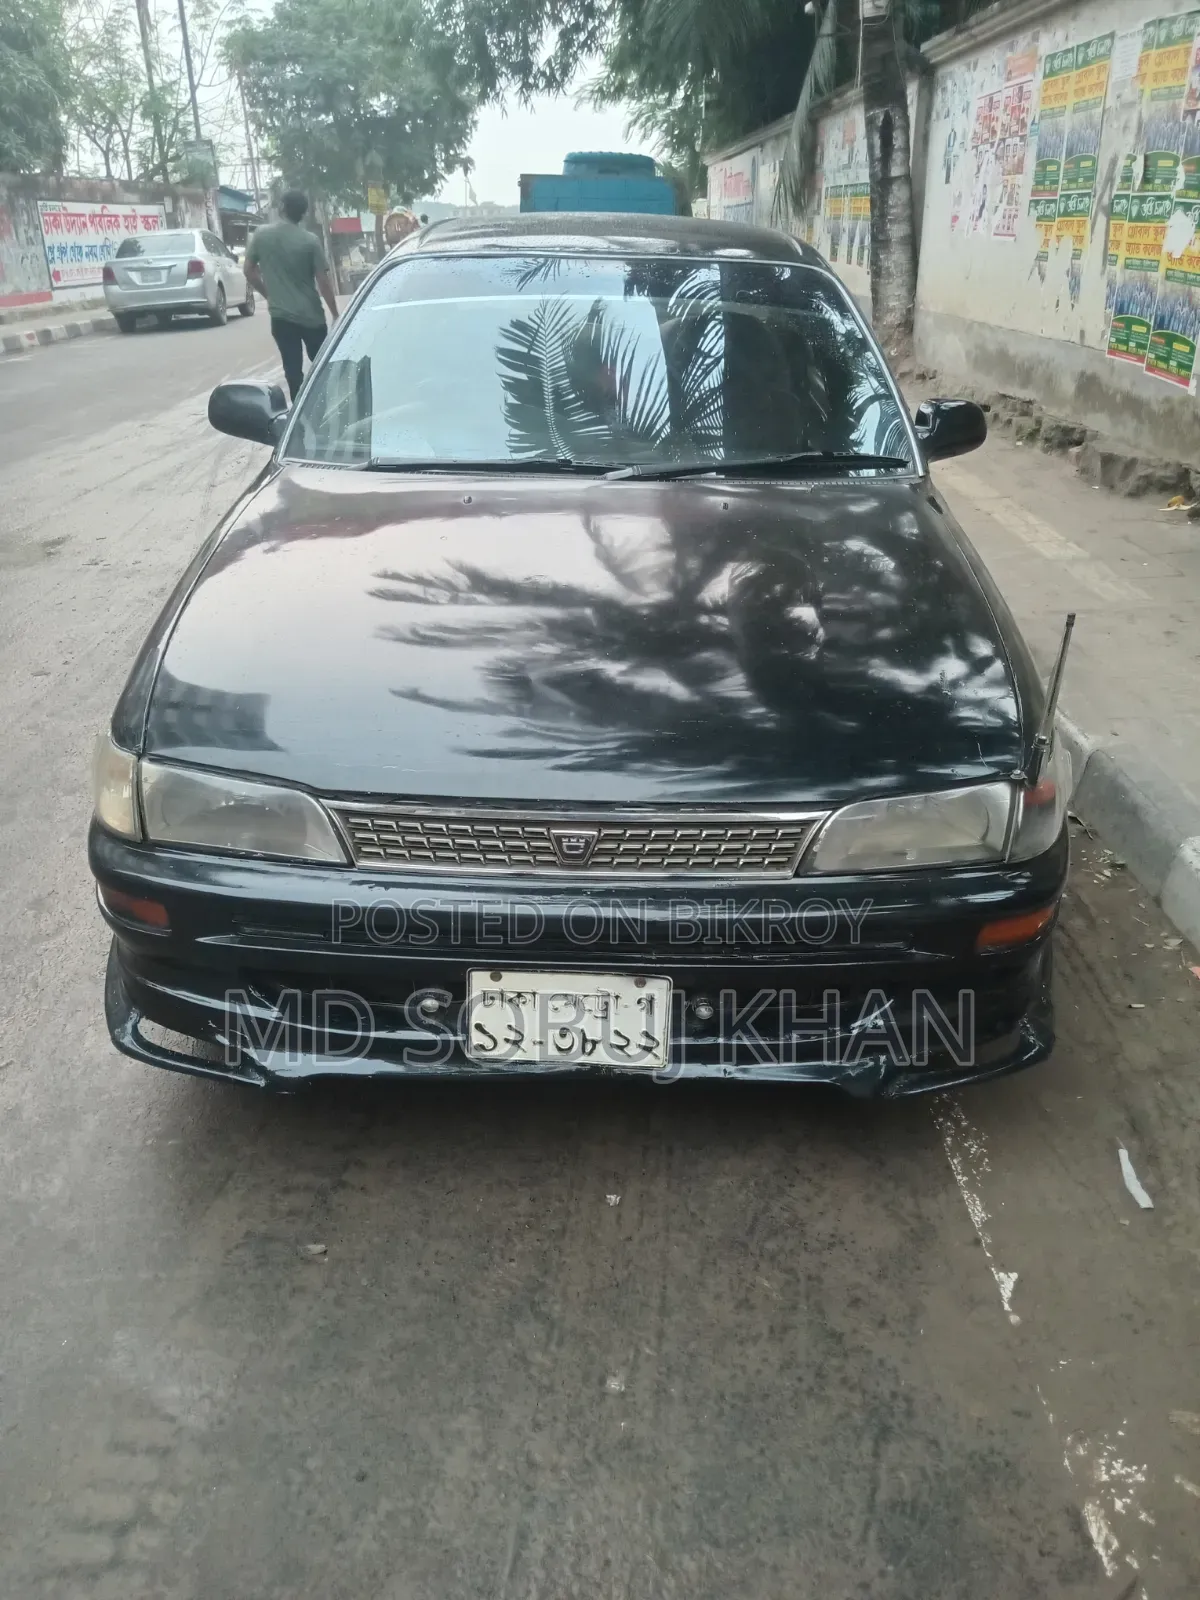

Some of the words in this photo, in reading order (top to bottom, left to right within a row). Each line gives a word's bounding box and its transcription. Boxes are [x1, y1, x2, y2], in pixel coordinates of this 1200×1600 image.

[42, 213, 63, 236] ঢাকা
[88, 205, 120, 235] পাবলিক
[122, 208, 138, 234] হাই
[481, 988, 540, 1011] ঢাকা
